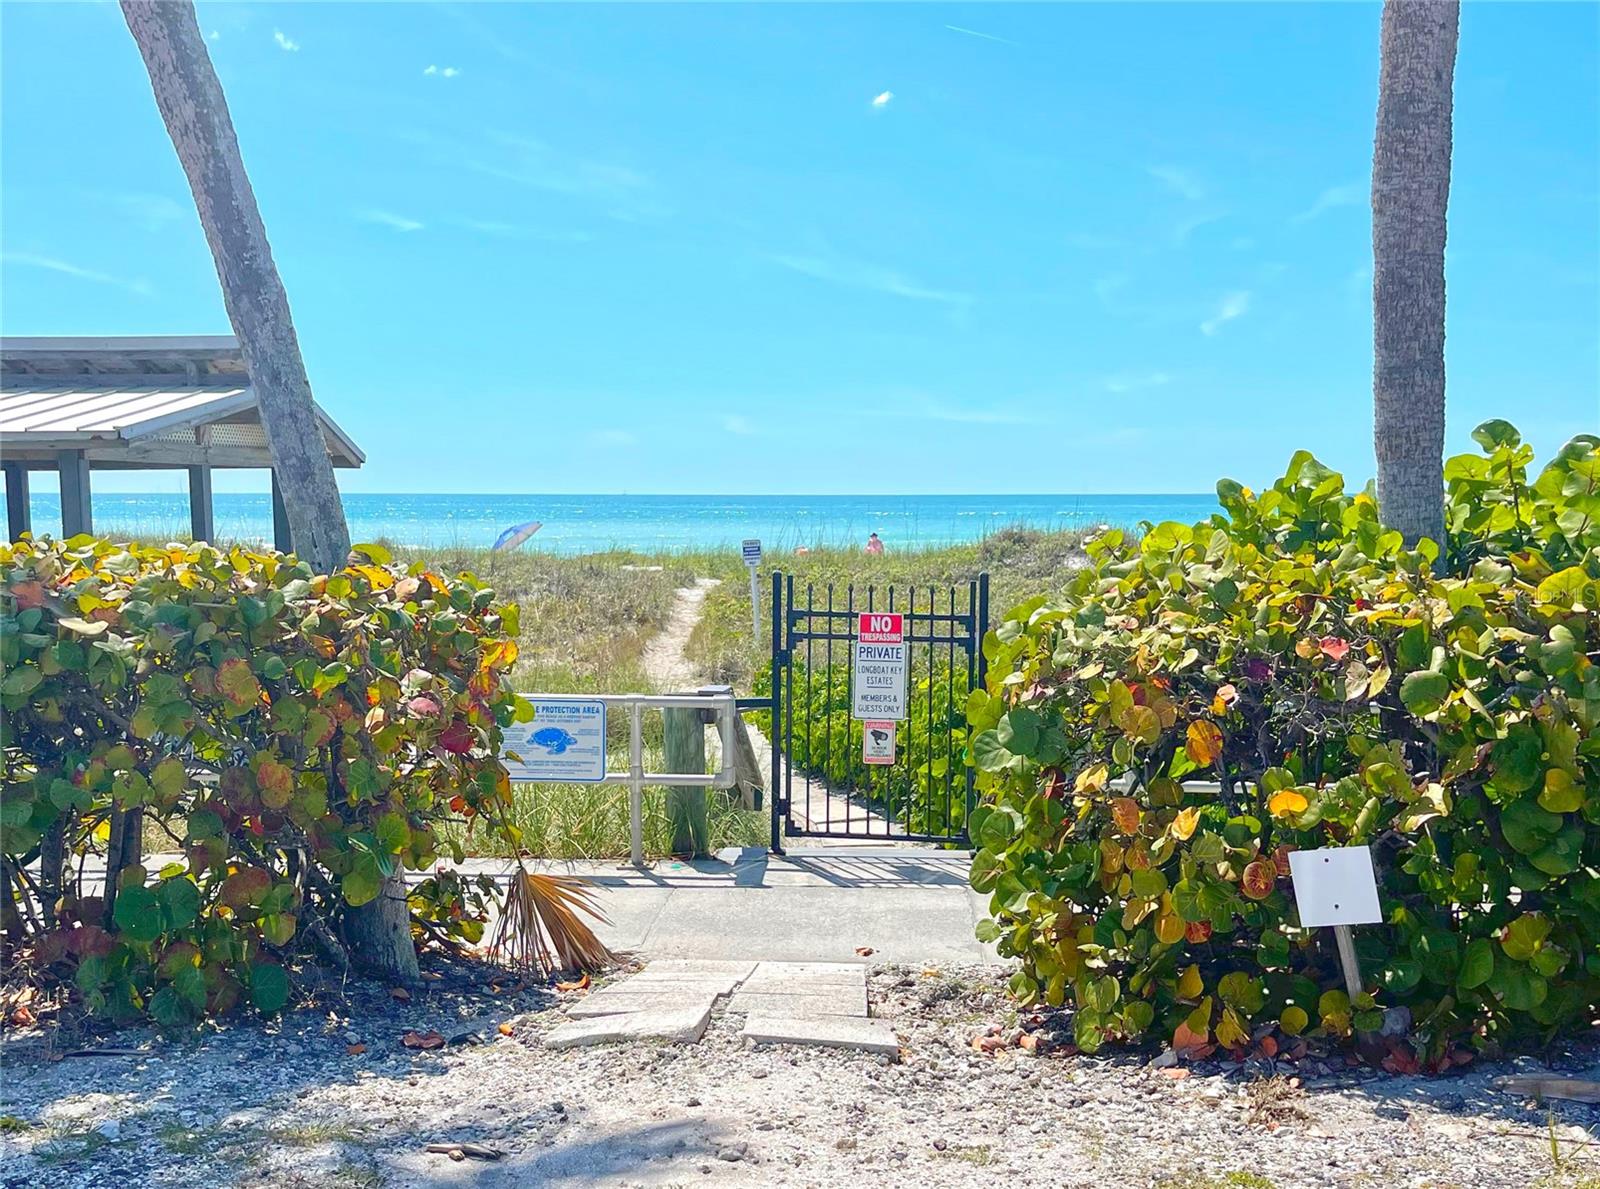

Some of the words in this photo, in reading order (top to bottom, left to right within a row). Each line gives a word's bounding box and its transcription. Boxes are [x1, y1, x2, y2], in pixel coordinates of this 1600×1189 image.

[870, 616, 892, 633] NO
[860, 632, 901, 642] TRESPASSING
[859, 646, 902, 659] PRIVATE
[857, 665, 889, 674] LONGBOAT
[890, 666, 903, 675] KEY
[866, 676, 893, 685] ESTATES
[861, 694, 892, 702] MEMBERS
[892, 695, 898, 703] &
[541, 706, 581, 714] PROTECTION
[582, 706, 600, 714] AREA
[857, 704, 883, 713] GUESTS
[883, 705, 900, 713] ONLY
